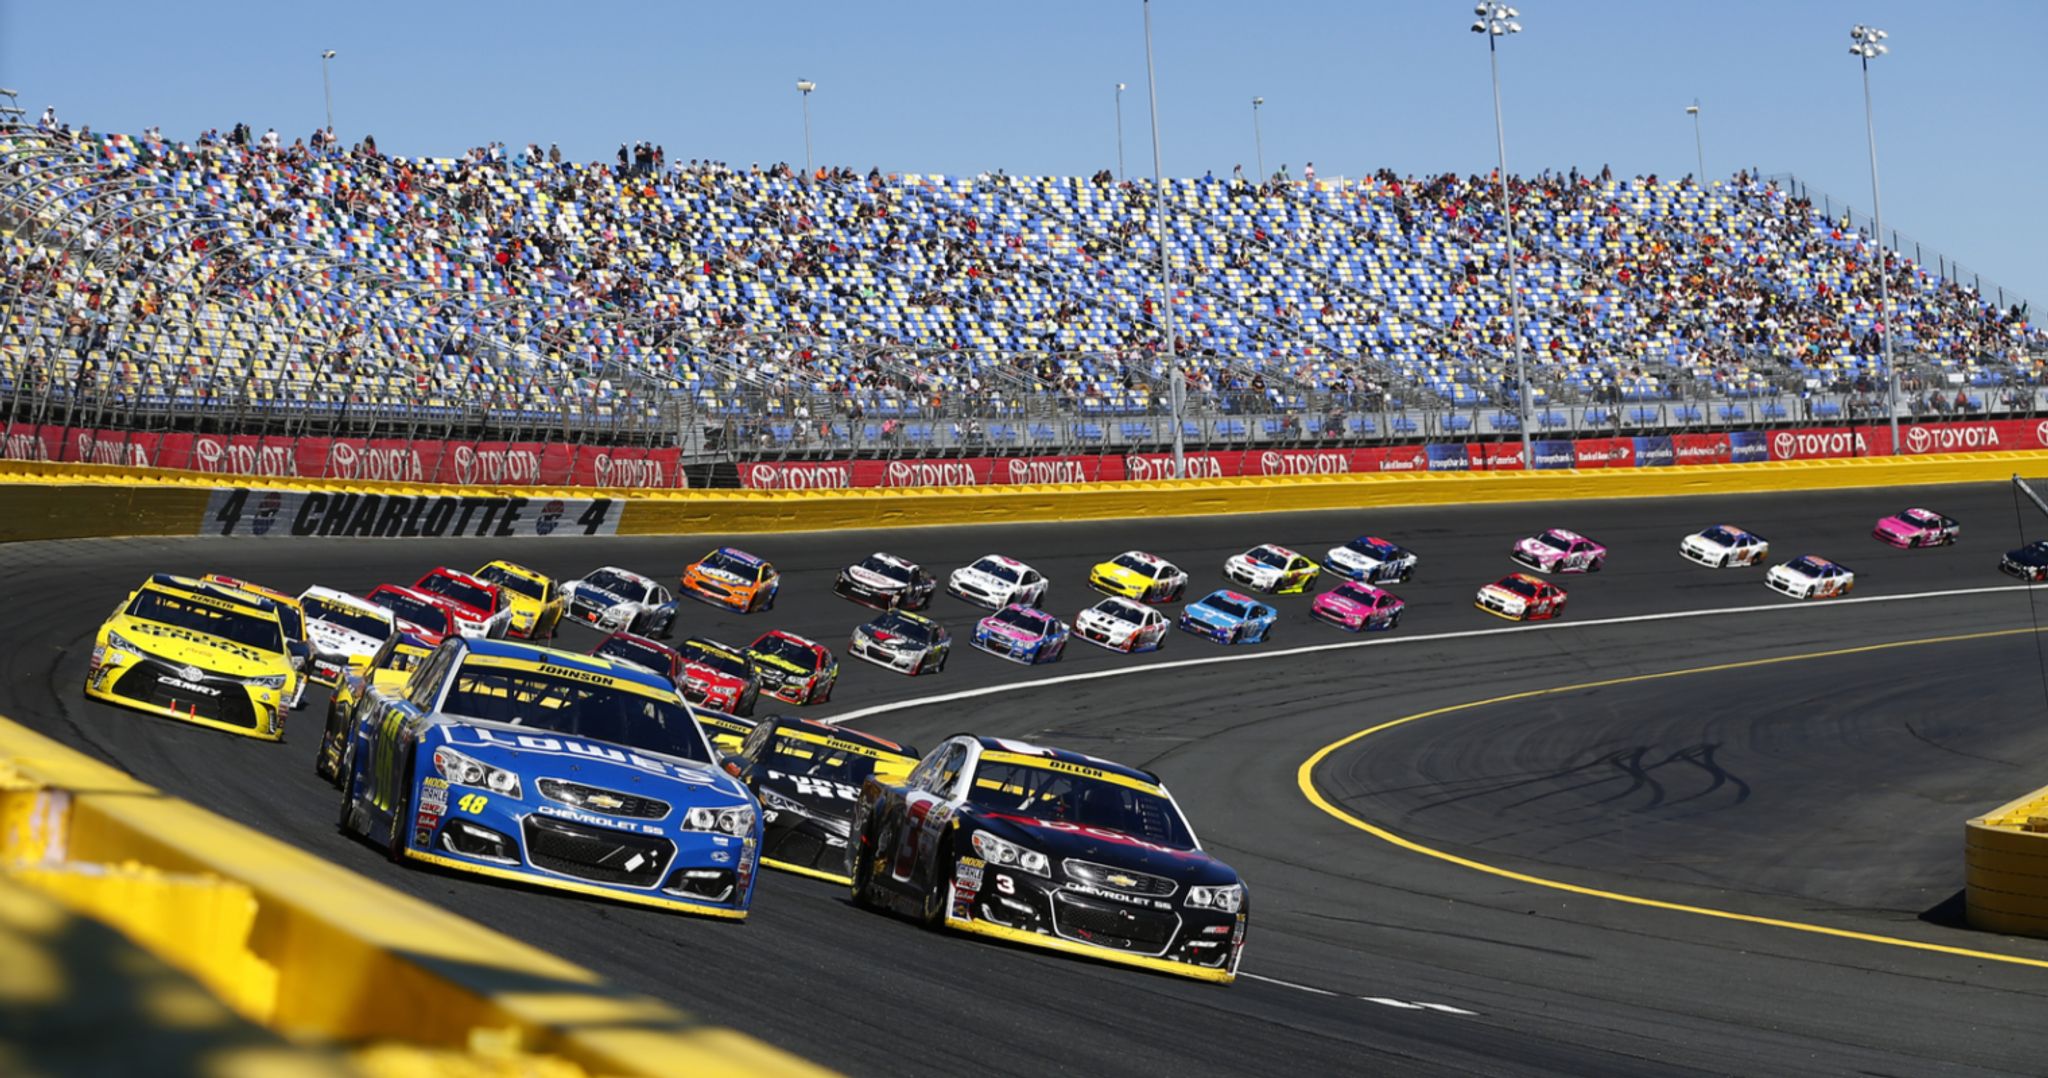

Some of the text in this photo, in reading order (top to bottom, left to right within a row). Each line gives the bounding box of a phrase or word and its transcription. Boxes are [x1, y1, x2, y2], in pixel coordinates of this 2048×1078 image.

[1796, 433, 1867, 454] TOYOTA
[1931, 427, 1999, 449] TOYOTA
[223, 445, 297, 477] TOYOTA
[359, 449, 423, 481] TOYOTA
[478, 451, 541, 480] TOYOTA
[1030, 461, 1086, 484] TOYOTA
[1284, 453, 1349, 475] TOYOTA
[614, 459, 664, 487] TOYOTA
[782, 467, 848, 490] TOYOTA
[911, 463, 976, 487] TOYOTA
[216, 487, 612, 537] 4 CHARLOTTE 4
[190, 593, 235, 610] KENSETH
[130, 624, 270, 666] GENERAL
[157, 676, 222, 697] CAMRY
[537, 664, 614, 687] JOHNSON
[476, 725, 716, 784] LOWE'S
[826, 738, 861, 754] TRUEX
[1050, 761, 1103, 778] DILLON
[458, 792, 488, 815] 48
[538, 805, 664, 836] CHEVROLET SS
[996, 873, 1015, 895] 3
[1066, 881, 1150, 907] CHEVROLET
